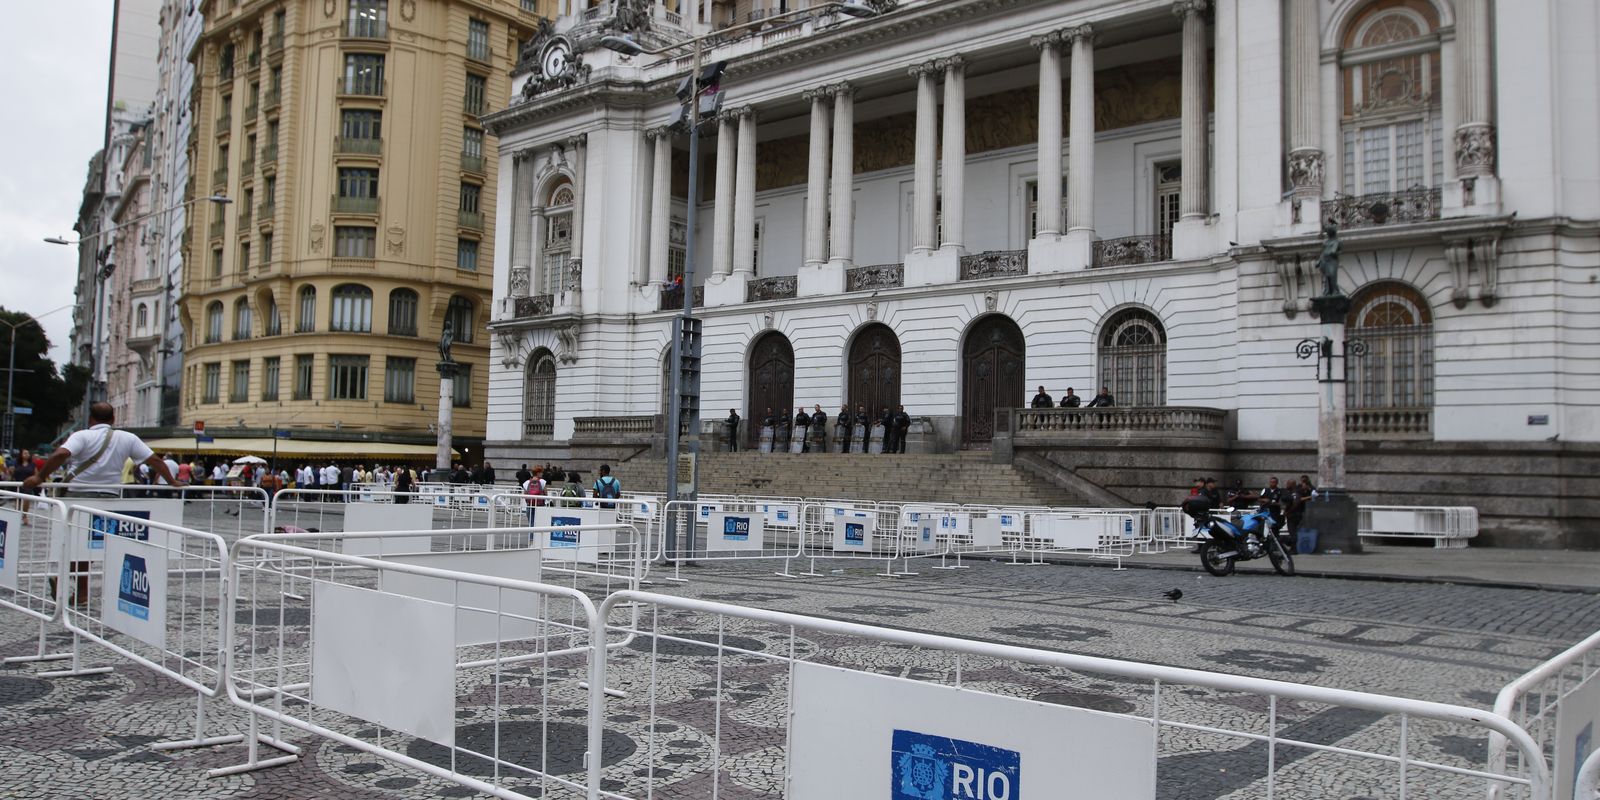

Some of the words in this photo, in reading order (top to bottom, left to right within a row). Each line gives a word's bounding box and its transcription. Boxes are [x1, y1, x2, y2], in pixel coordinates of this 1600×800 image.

[736, 521, 748, 531] RIO
[132, 570, 148, 593] RIO
[952, 762, 1010, 800] RIO
